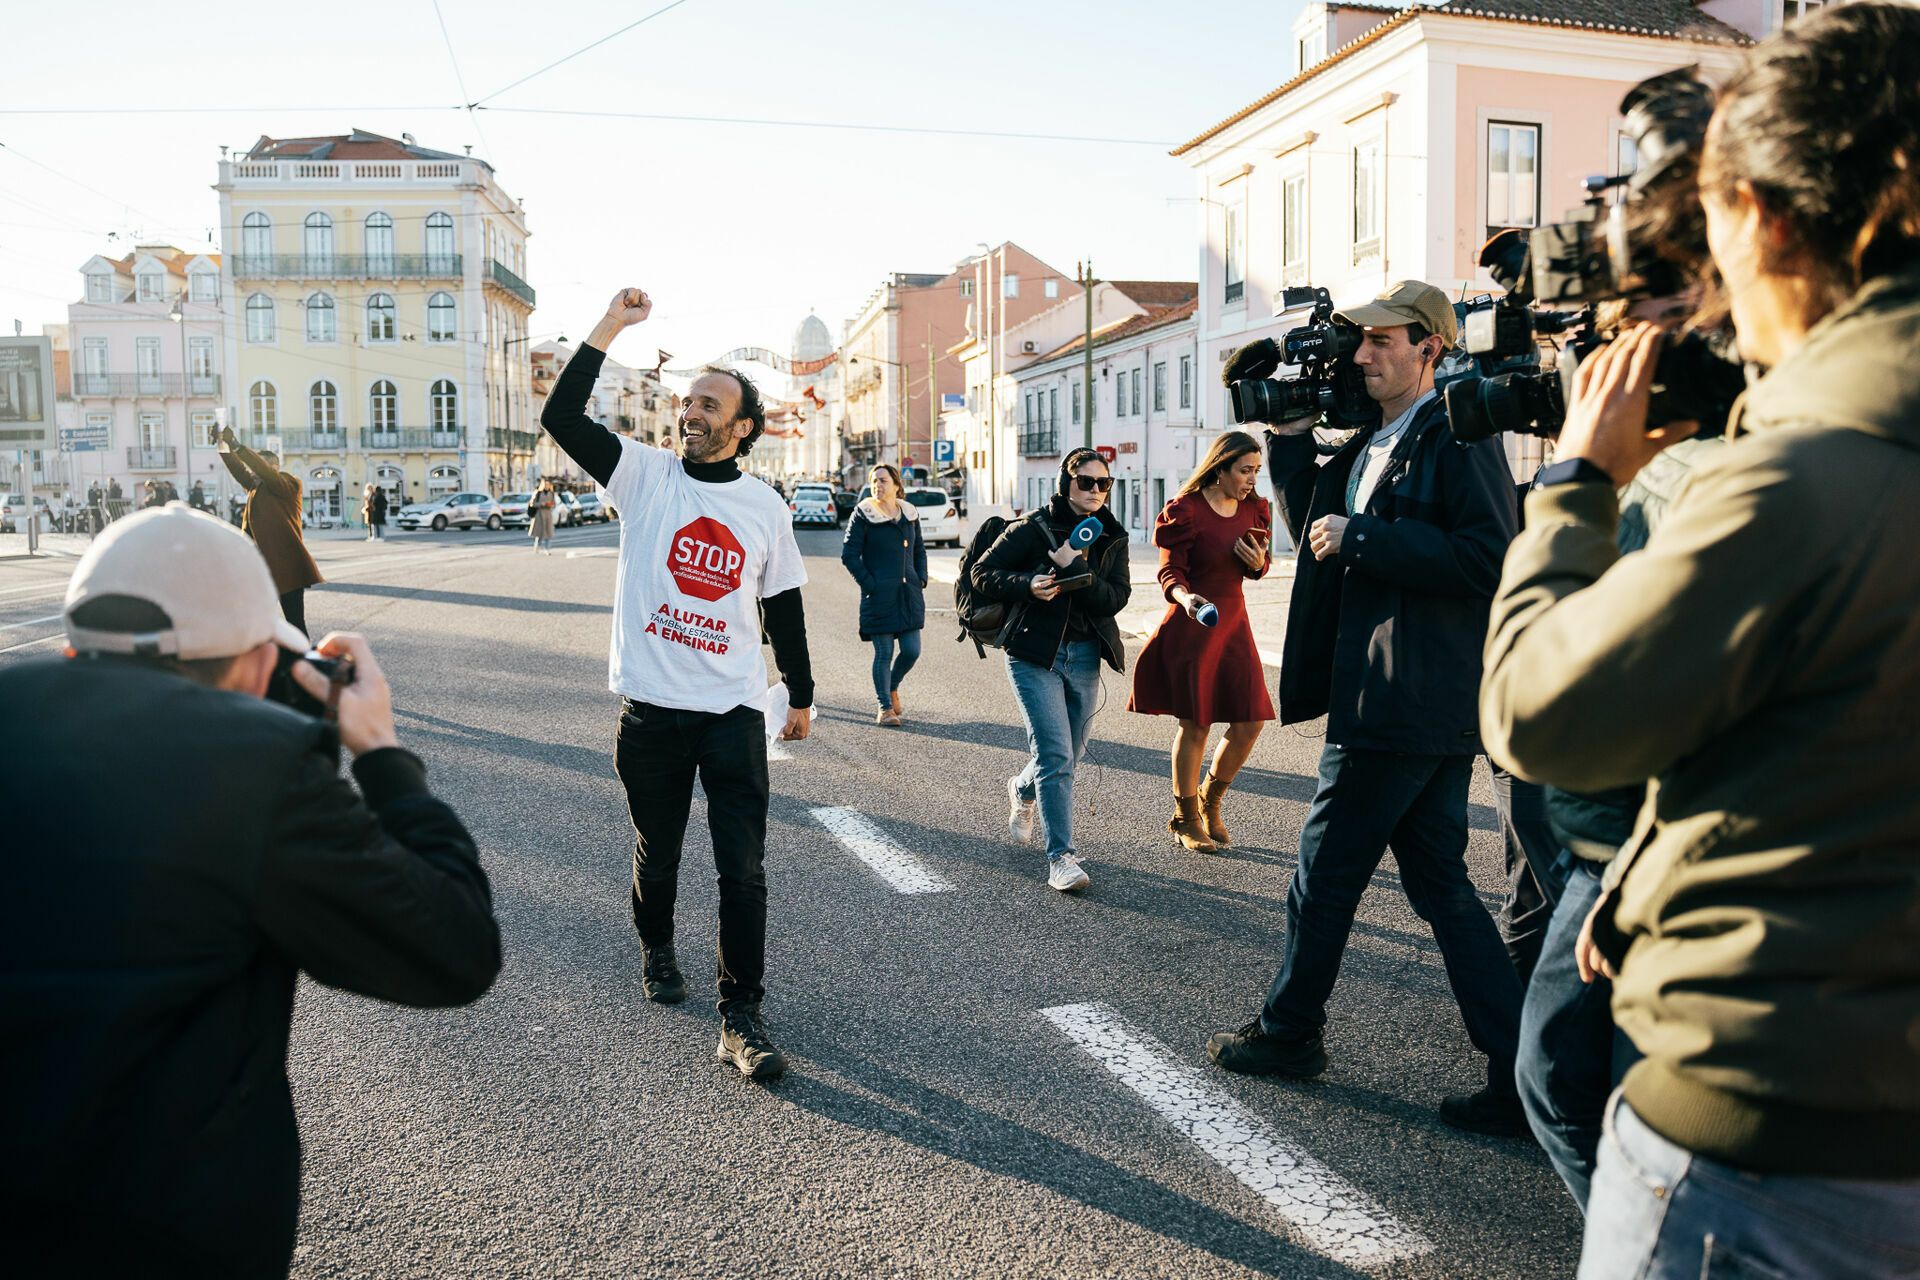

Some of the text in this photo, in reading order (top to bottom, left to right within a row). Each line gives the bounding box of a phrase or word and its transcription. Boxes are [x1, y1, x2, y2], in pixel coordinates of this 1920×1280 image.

[1302, 338, 1323, 347] RTP
[936, 441, 951, 460] P
[658, 603, 727, 632] A LUTAR
[644, 621, 729, 655] A ENSINAR
[688, 628, 731, 643] ESTAMOS
